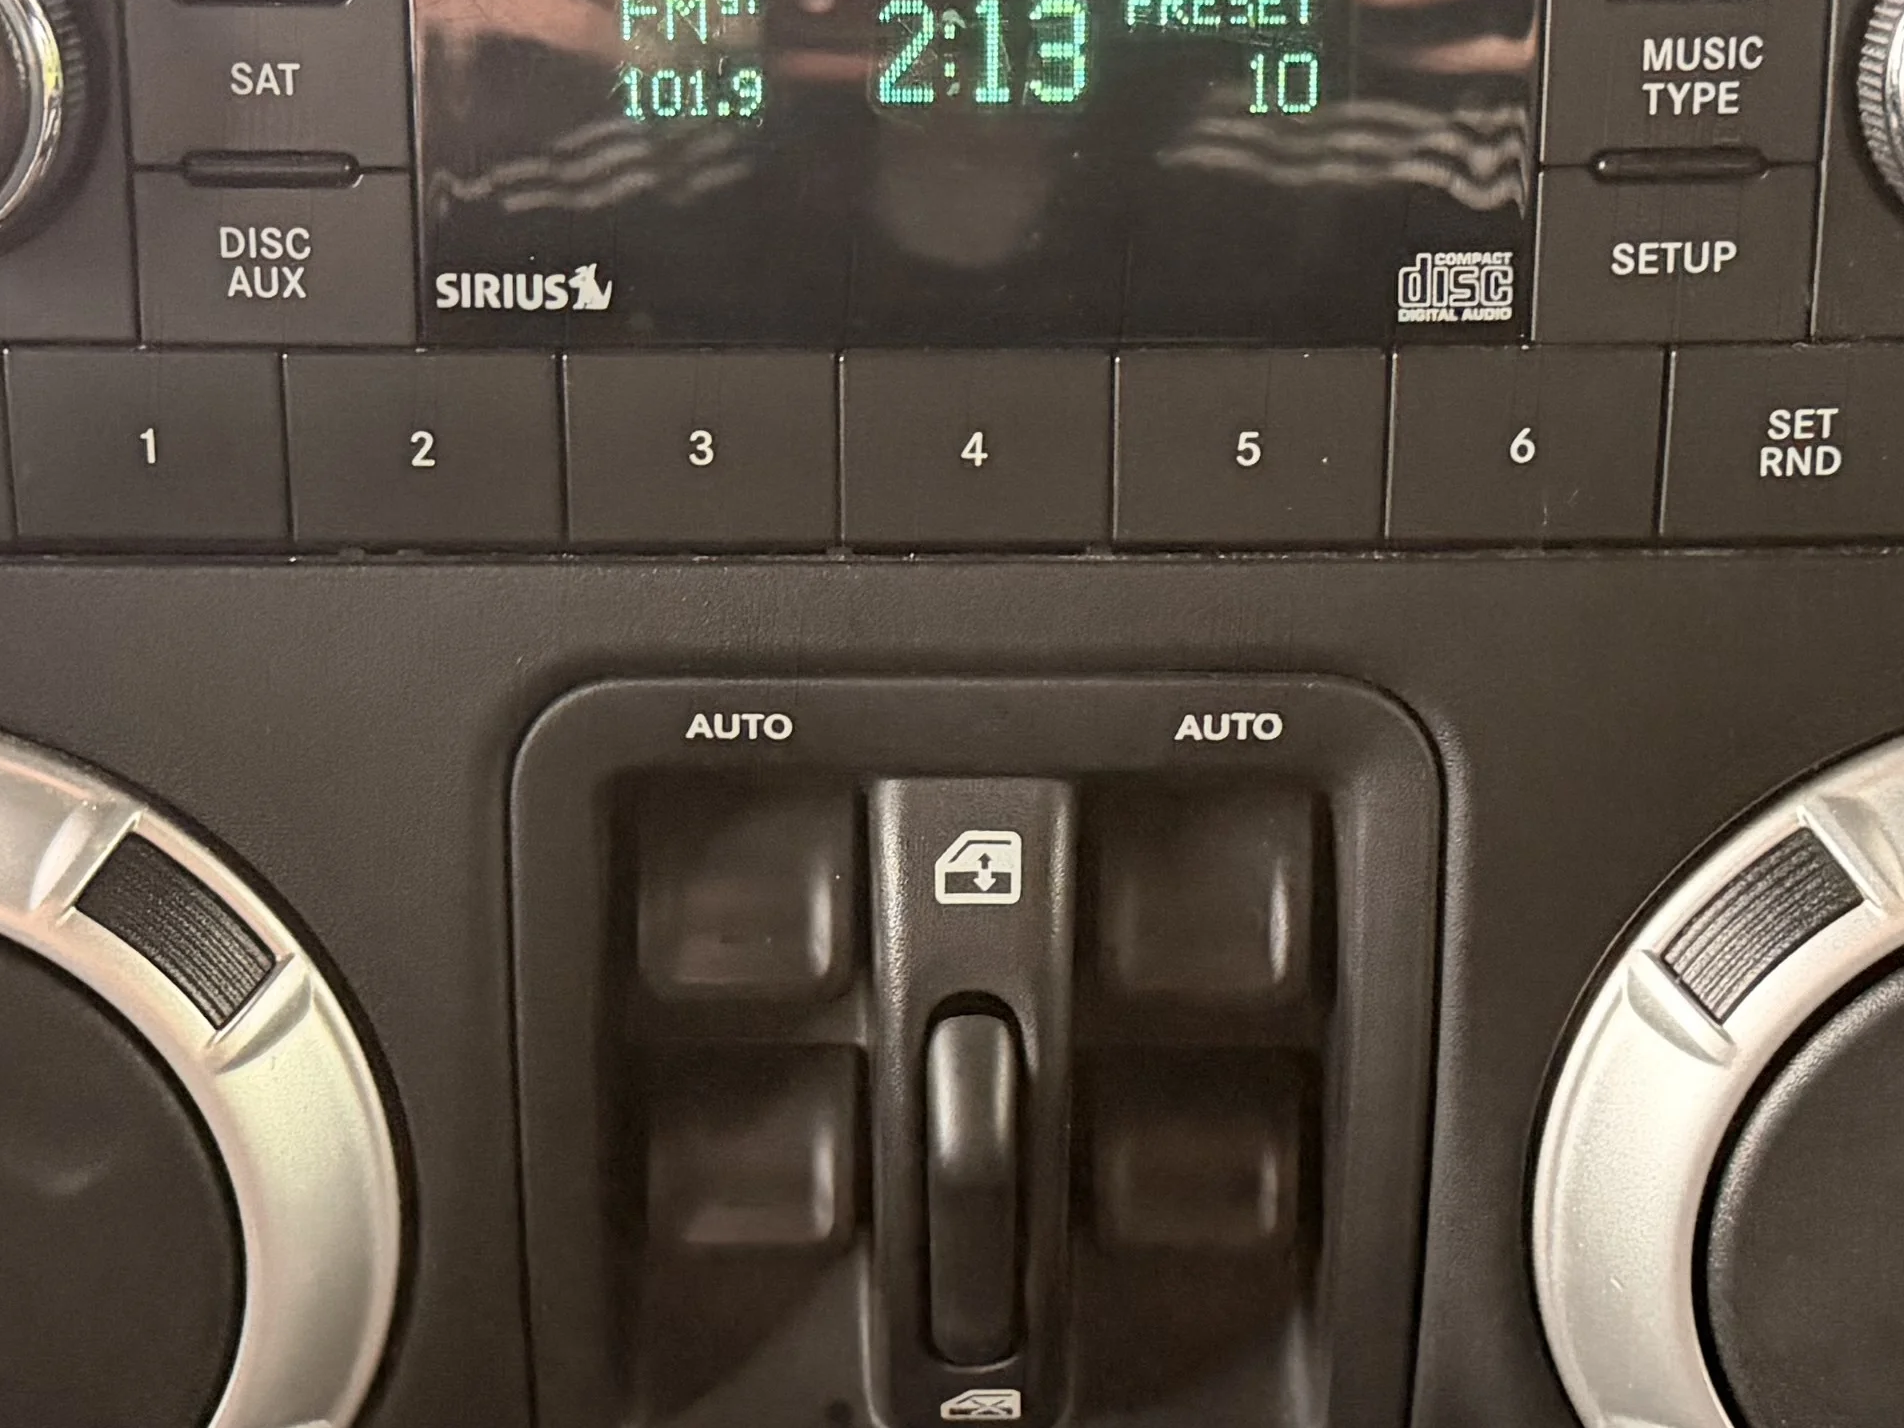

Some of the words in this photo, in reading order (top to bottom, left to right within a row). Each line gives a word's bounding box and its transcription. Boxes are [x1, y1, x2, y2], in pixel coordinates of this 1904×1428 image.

[1643, 35, 1764, 71] MUSIC
[231, 62, 301, 96] SAT
[623, 69, 763, 117] 101.9
[1249, 51, 1318, 114] 10
[1642, 80, 1740, 116] TYPE
[219, 226, 311, 260] DISC
[1434, 251, 1513, 266] COMPACT
[1611, 240, 1737, 275] SETUP
[227, 265, 307, 299] AUX
[435, 272, 569, 311] SIRIUS
[1397, 308, 1458, 322] DIGITAL
[1461, 307, 1513, 321] AUDIO
[1767, 407, 1839, 440] SET
[140, 428, 156, 464] 1
[410, 430, 436, 467] 2
[689, 430, 714, 466] 3
[960, 431, 989, 467] 4
[1236, 431, 1261, 467] 5
[1510, 427, 1536, 464] 6
[1760, 445, 1842, 477] RND
[685, 713, 793, 740] AUTO
[1174, 712, 1283, 741] AUTO
